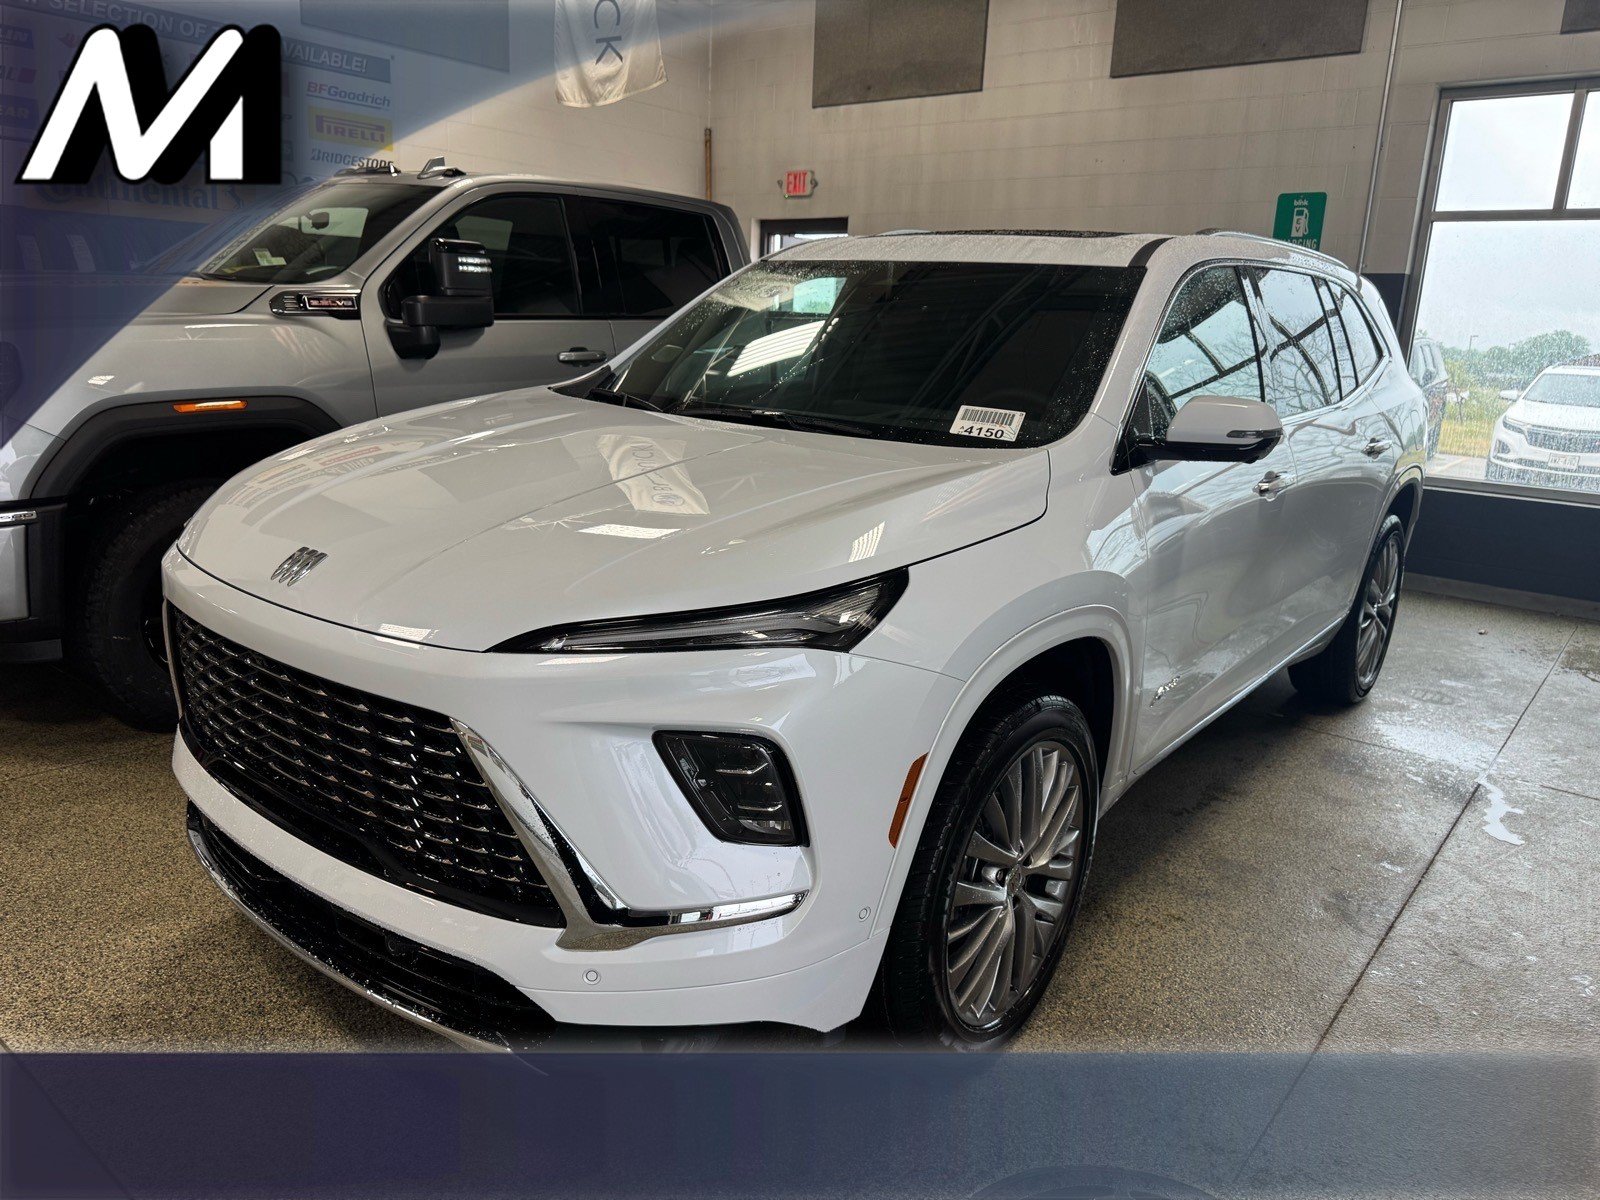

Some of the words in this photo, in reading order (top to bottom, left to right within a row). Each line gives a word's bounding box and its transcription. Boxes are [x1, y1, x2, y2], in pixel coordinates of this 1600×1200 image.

[178, 20, 207, 39] OF
[281, 41, 368, 73] VAILABLE!
[306, 81, 391, 108] BFGoodrich
[315, 114, 386, 143] PIRELLI
[786, 171, 808, 195] EXIT
[964, 425, 1005, 439] 4150
